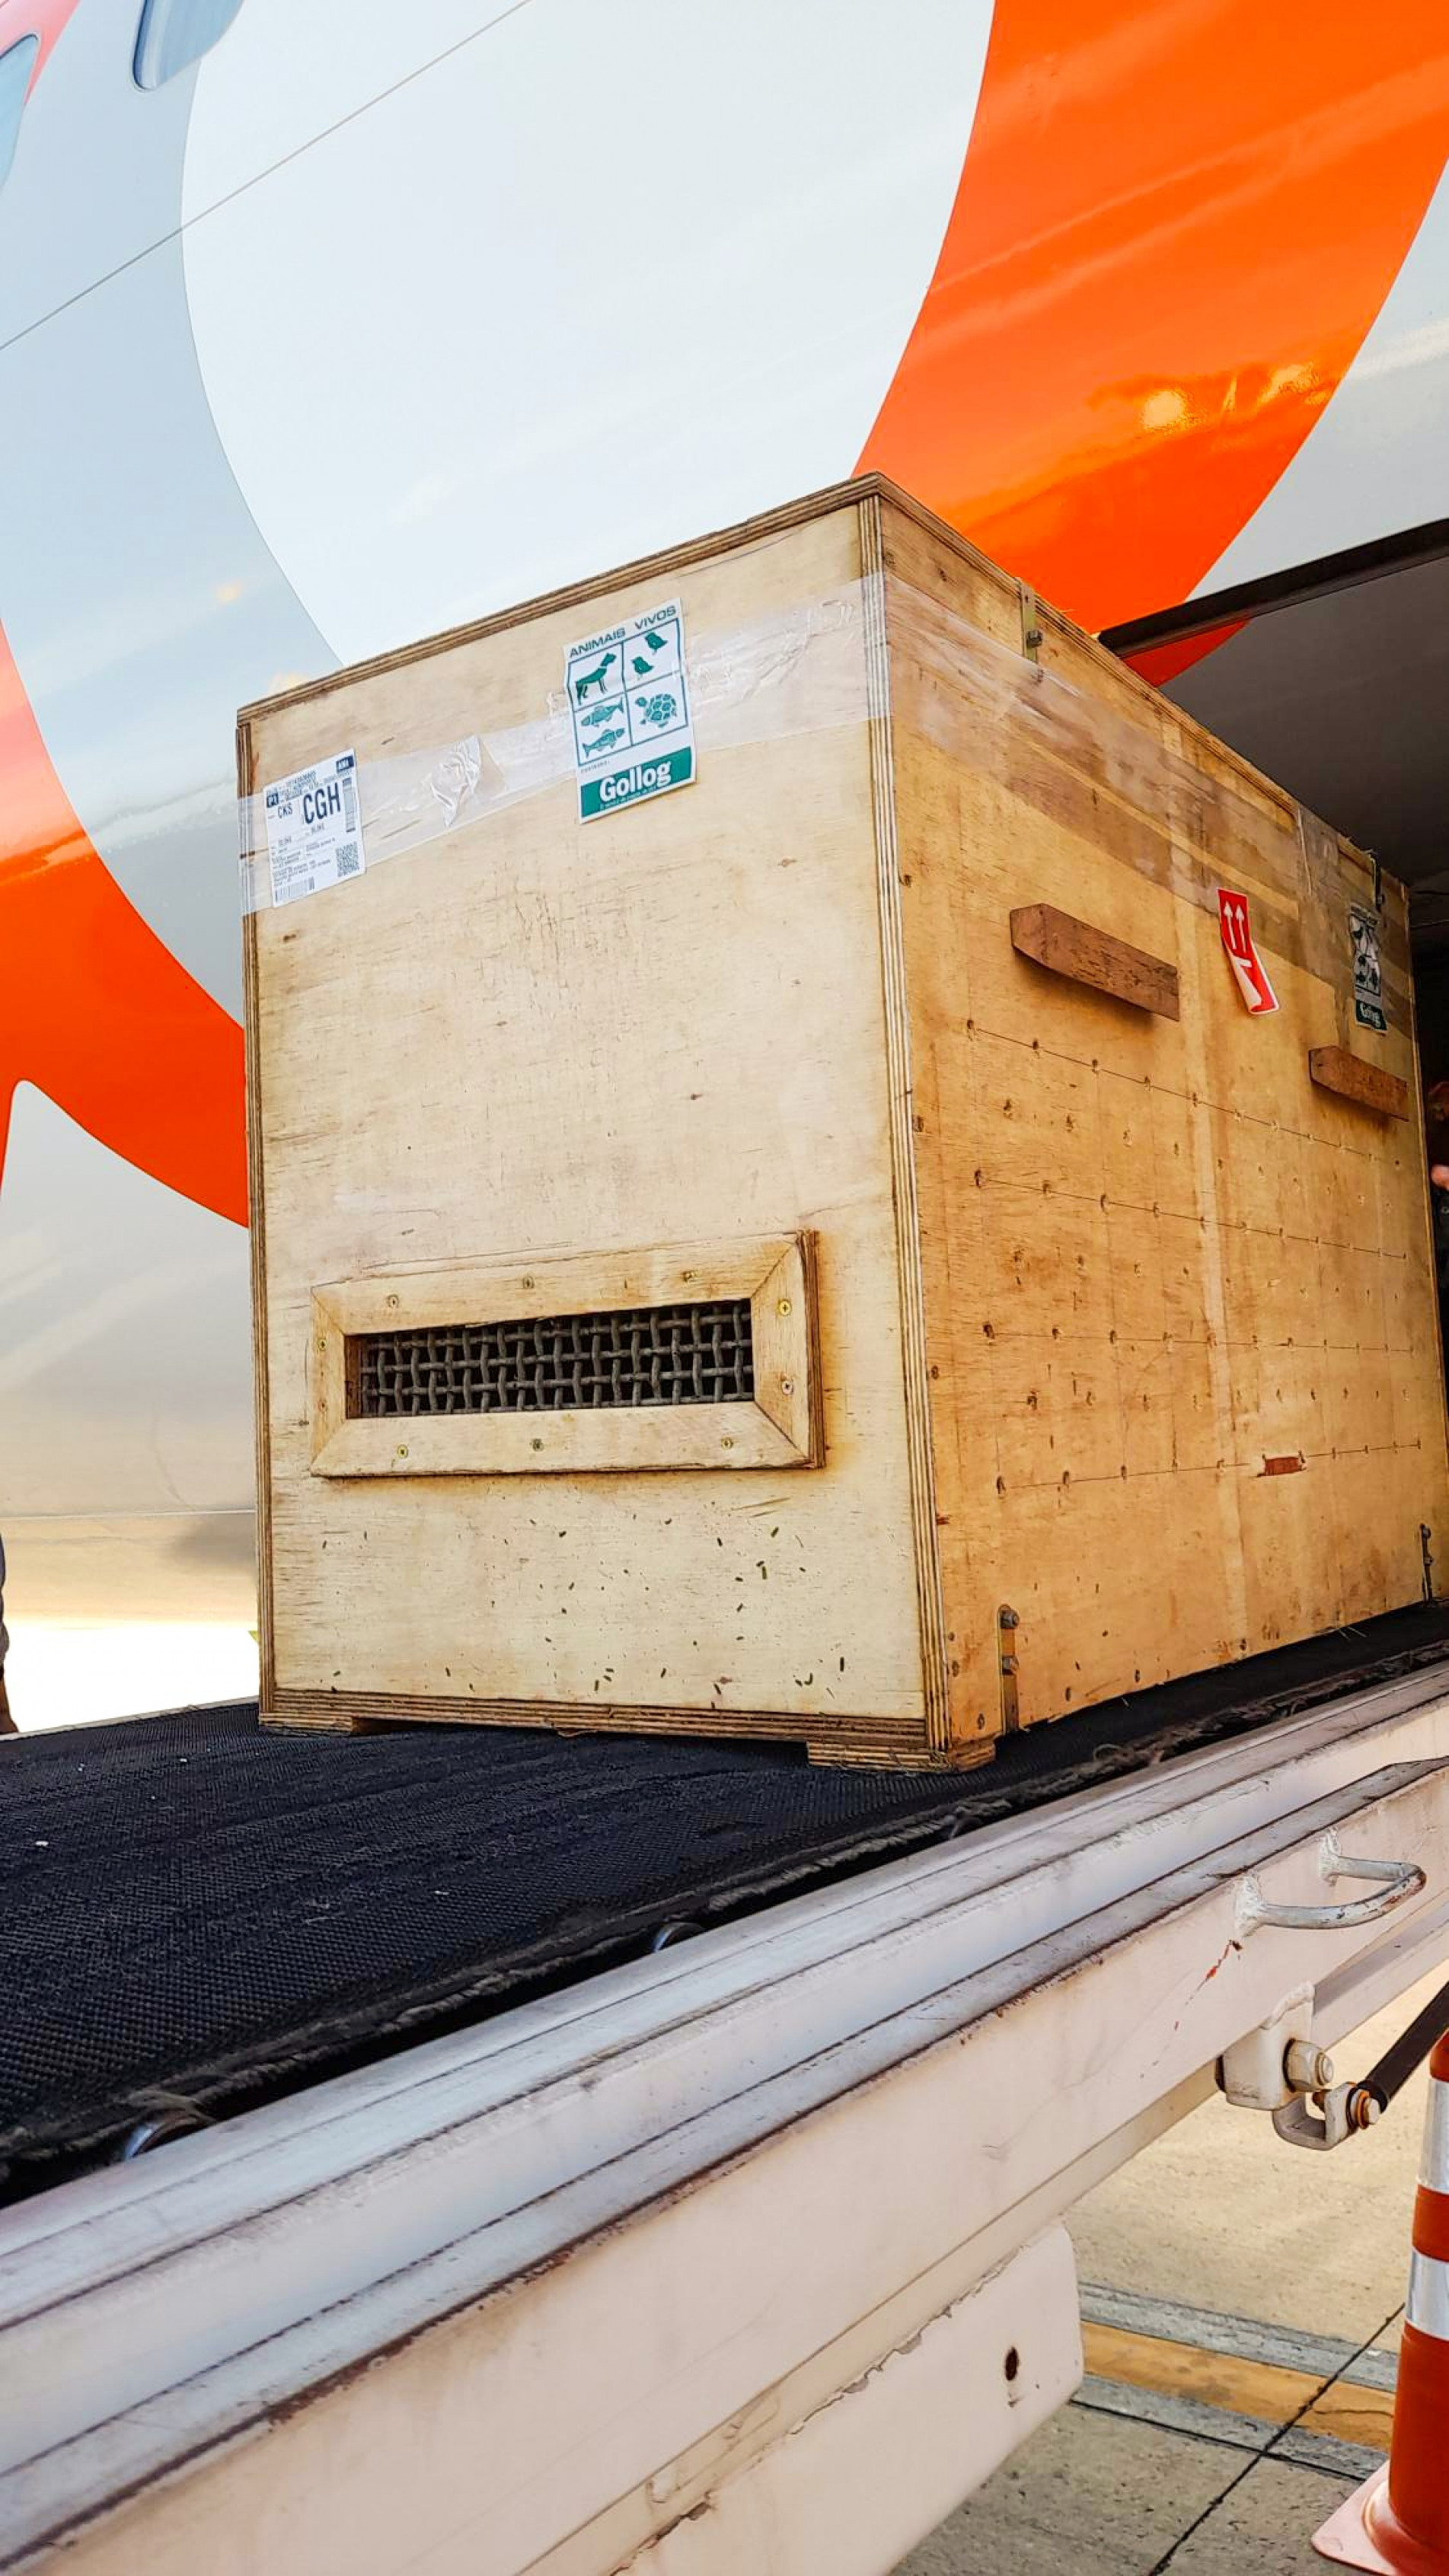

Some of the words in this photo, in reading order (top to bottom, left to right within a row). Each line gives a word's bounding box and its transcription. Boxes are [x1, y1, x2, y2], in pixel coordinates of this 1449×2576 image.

[569, 628, 626, 658] ANIMAIS
[634, 604, 677, 630] VIVOS
[599, 760, 672, 802] Gollog
[277, 802, 293, 819] CKS
[302, 781, 341, 825] CGH
